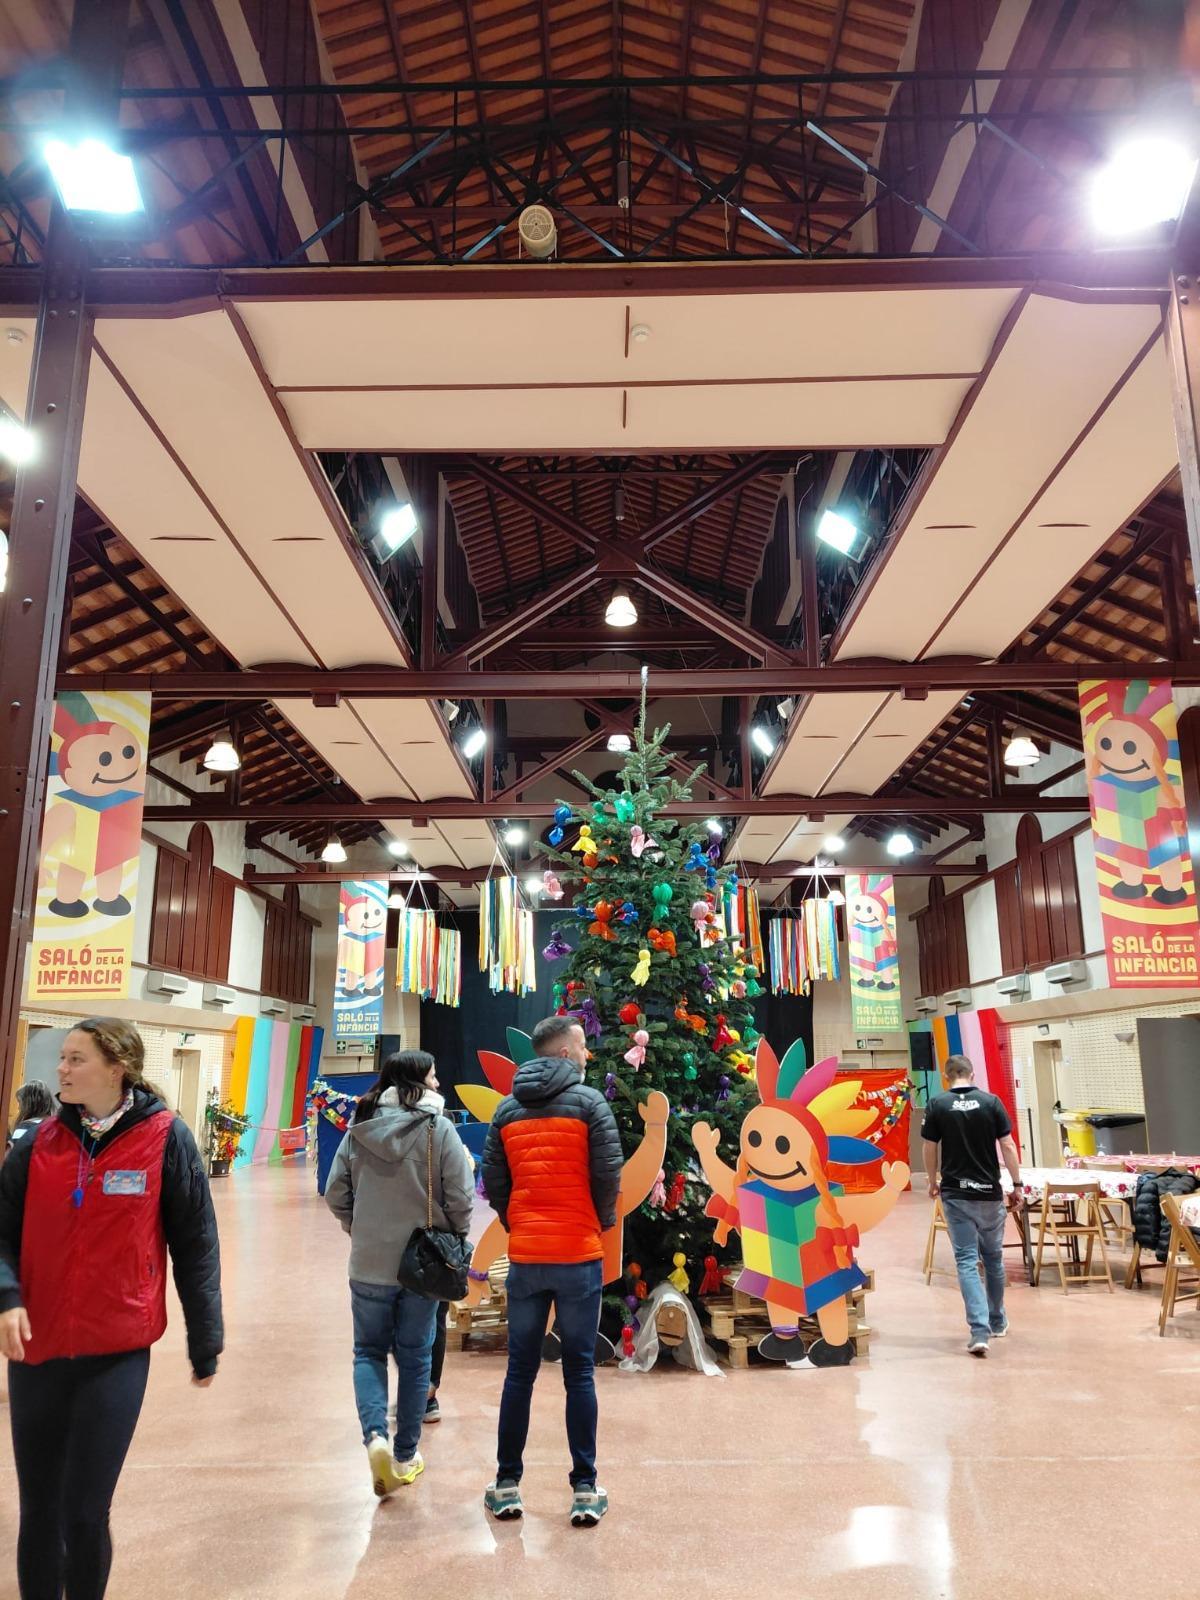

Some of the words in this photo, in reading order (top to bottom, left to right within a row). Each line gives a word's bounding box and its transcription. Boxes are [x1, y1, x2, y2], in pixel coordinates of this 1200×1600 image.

[1112, 931, 1165, 954] SALÓ
[1167, 944, 1181, 953] DE
[1183, 944, 1196, 953] LA
[38, 943, 92, 966] SALÓ
[96, 956, 109, 965] DE
[111, 956, 124, 965] LA
[1113, 954, 1198, 973] INFÀNCIA
[37, 967, 122, 985] INFÀNCIA
[336, 1010, 364, 1022] SALÓ
